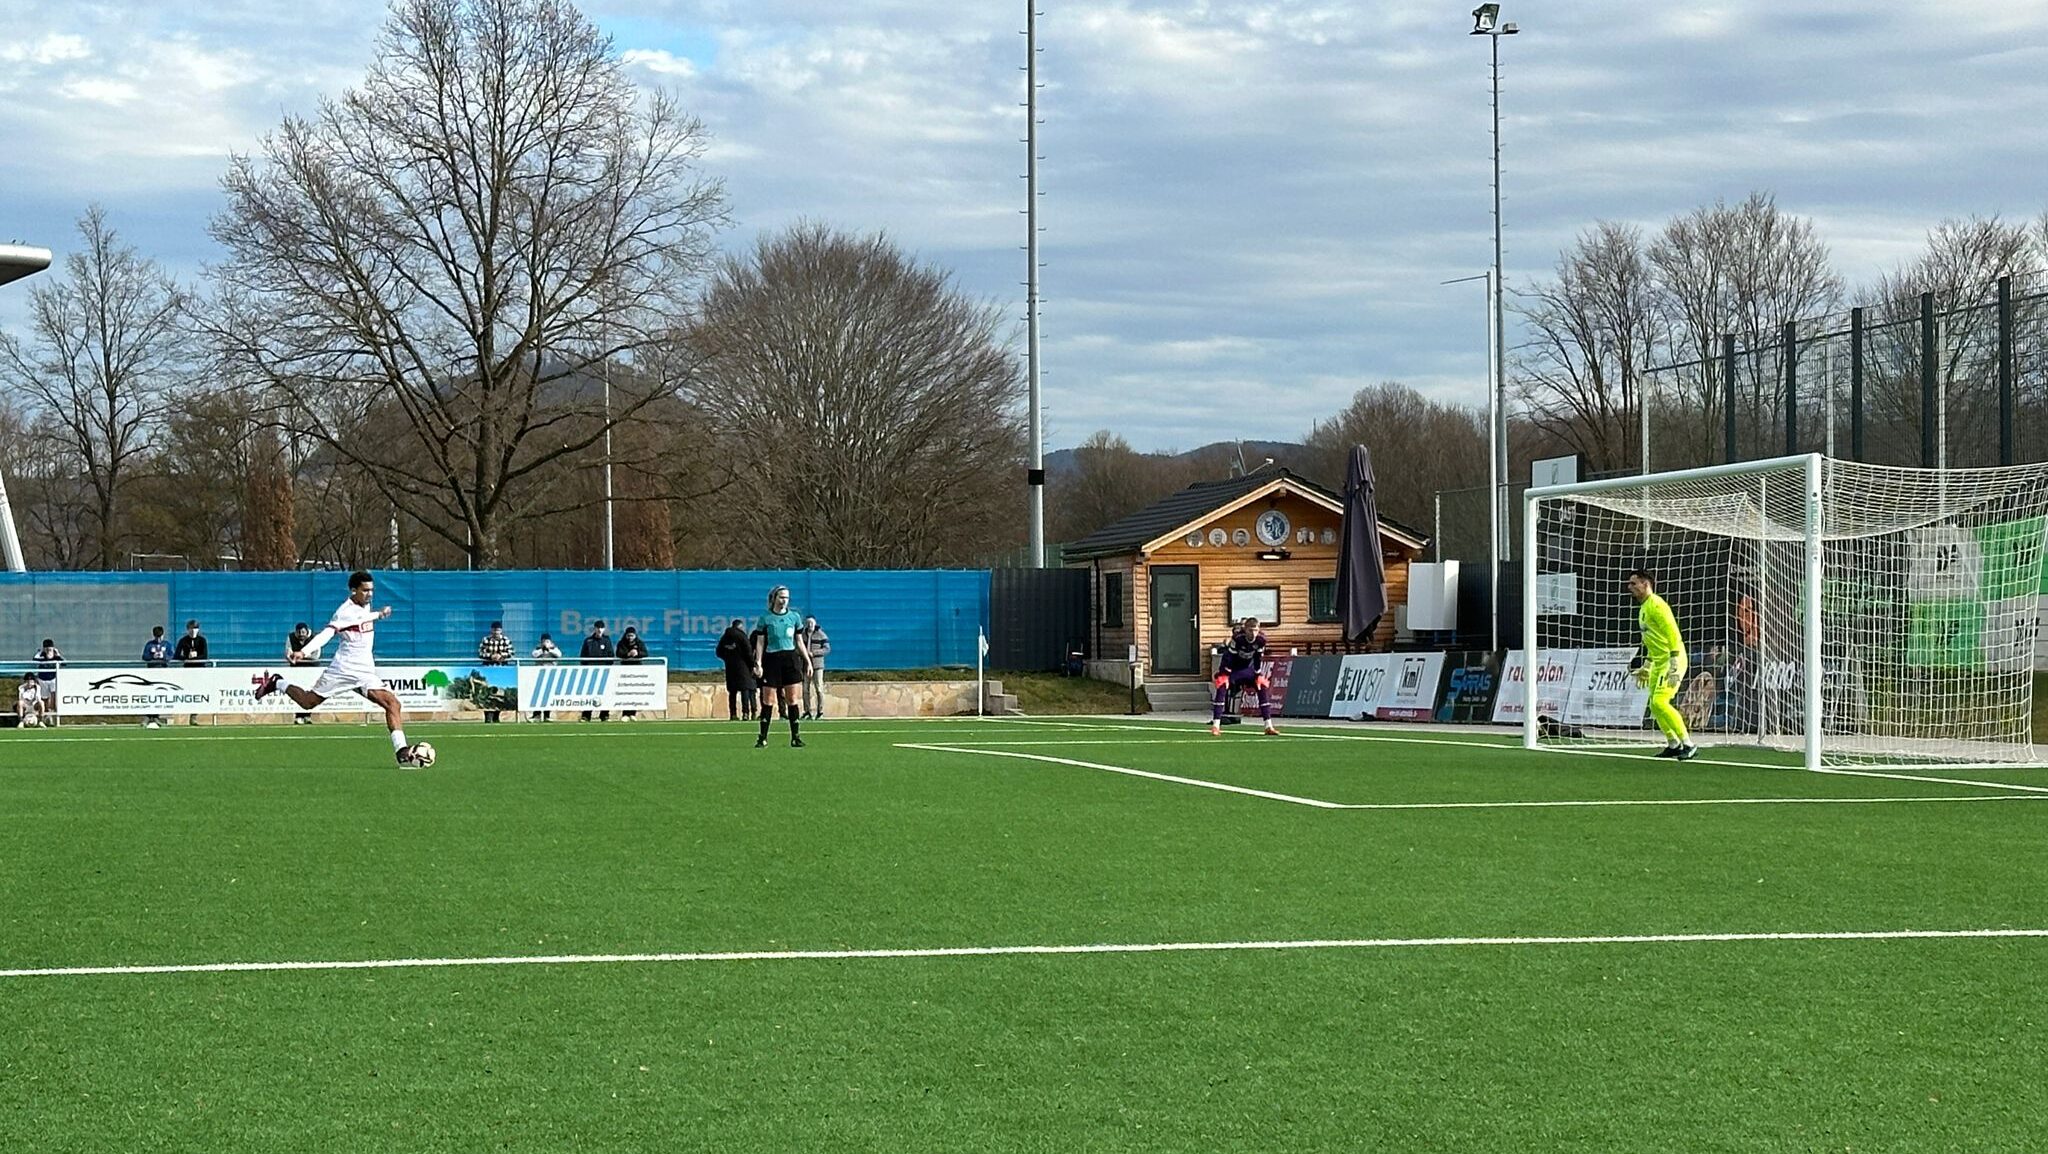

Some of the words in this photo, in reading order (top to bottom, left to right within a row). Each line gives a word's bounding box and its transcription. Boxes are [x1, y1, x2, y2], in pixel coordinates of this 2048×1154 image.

[561, 608, 656, 636] Bauer
[1588, 671, 1629, 691] STARK
[62, 695, 90, 704] CITY
[93, 695, 128, 704] CARS
[131, 694, 210, 704] REUTLINGEN
